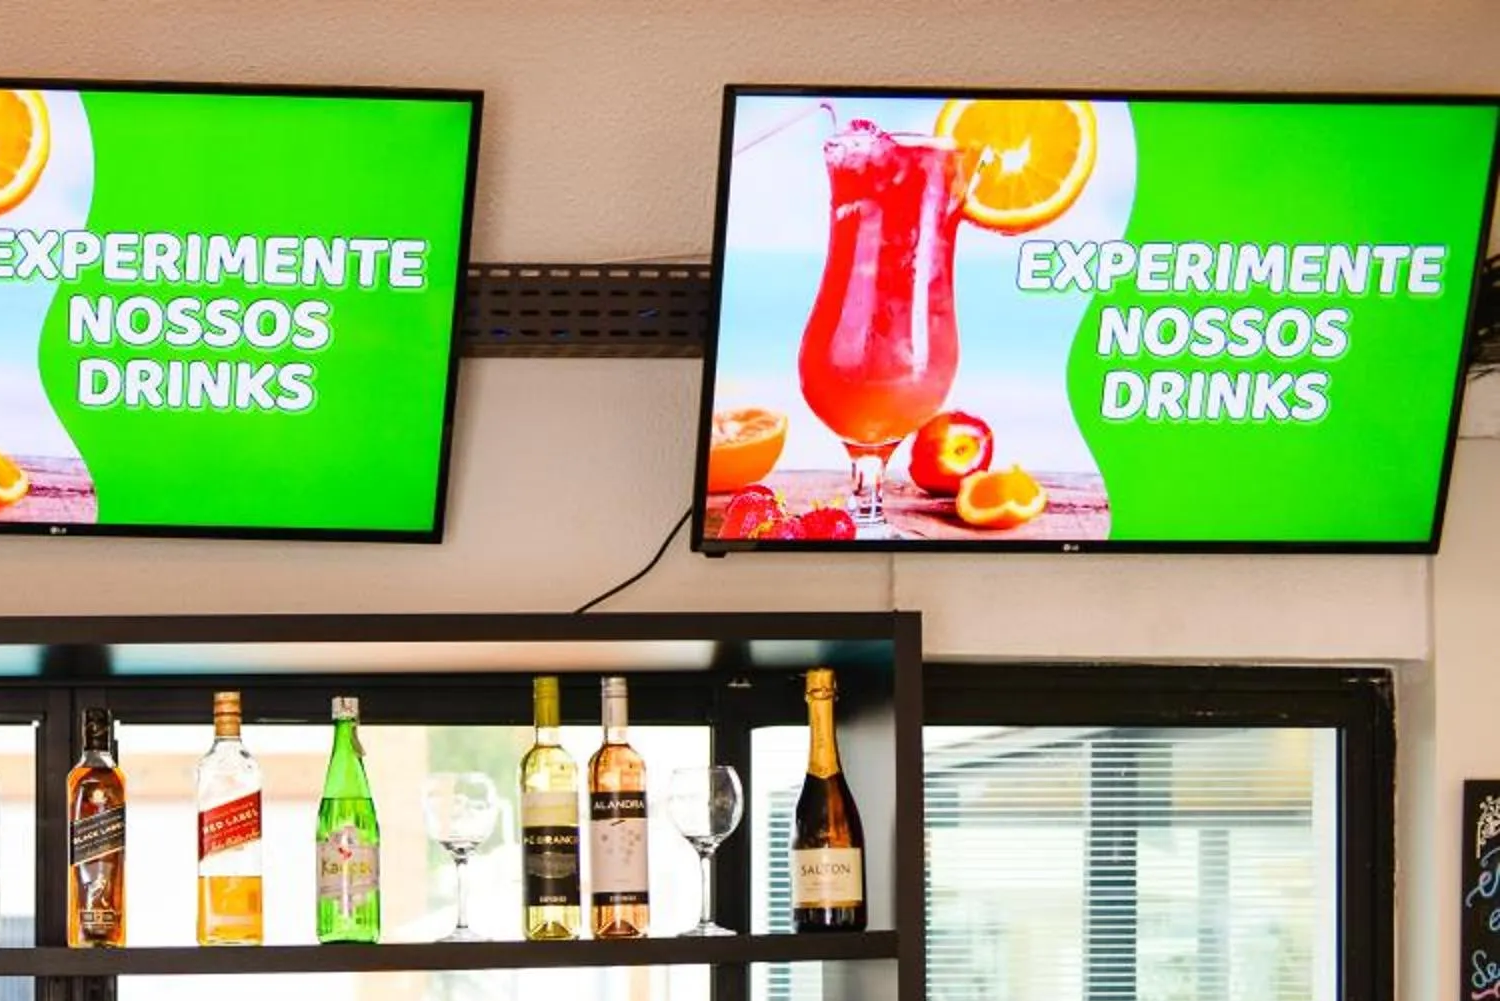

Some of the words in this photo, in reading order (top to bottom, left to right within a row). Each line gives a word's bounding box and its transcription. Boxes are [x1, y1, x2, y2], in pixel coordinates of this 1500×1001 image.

[1016, 239, 1446, 296] EXPERIMENTE
[68, 294, 330, 349] NOSSOS
[1097, 306, 1350, 358] NOSSOS
[77, 358, 315, 411] DRINKS
[1100, 369, 1329, 422] DRINKS
[593, 799, 645, 810] ALANDRA
[800, 860, 852, 877] SALTON
